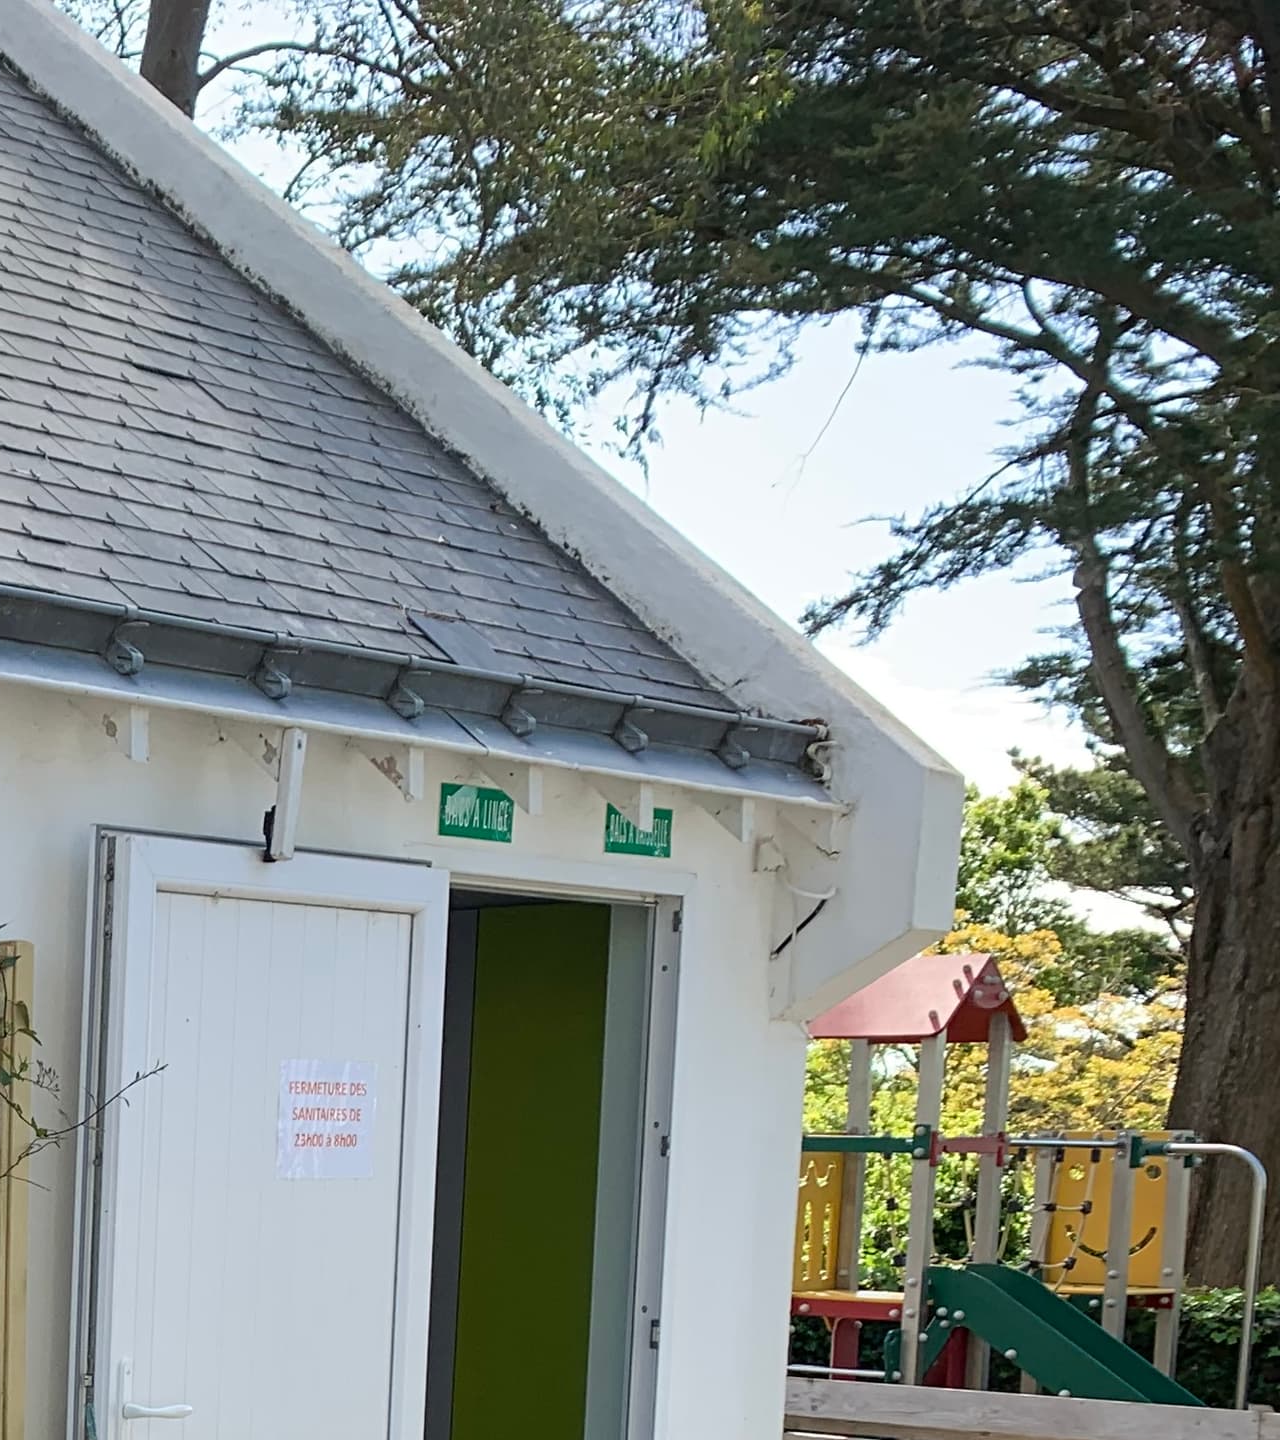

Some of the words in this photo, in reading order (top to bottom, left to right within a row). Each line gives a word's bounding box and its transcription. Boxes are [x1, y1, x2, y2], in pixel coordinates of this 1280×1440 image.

[289, 1081, 347, 1096] FERMETURE
[349, 1083, 367, 1096] DES
[292, 1107, 347, 1121] SANITAIRES
[349, 1108, 361, 1121] DE
[294, 1133, 324, 1147] 23h00
[325, 1133, 332, 1147] à
[333, 1133, 357, 1147] 8h00
